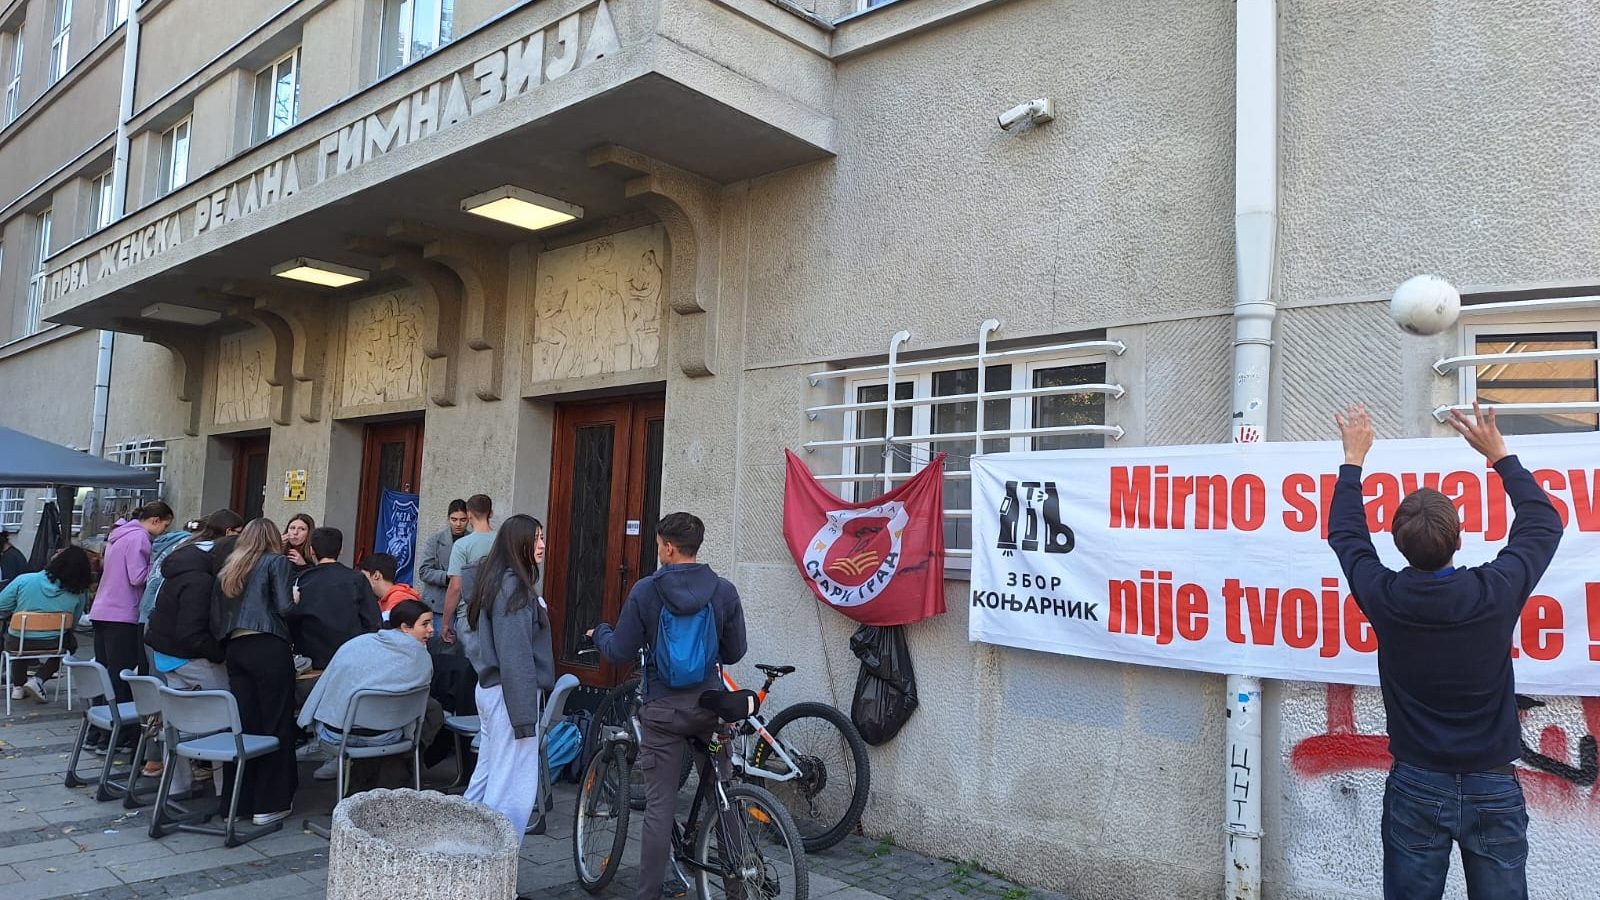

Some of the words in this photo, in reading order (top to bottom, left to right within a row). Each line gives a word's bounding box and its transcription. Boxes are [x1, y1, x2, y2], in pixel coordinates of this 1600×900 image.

[51, 258, 89, 299] ПРВА
[97, 212, 182, 281] ЖЕНСКА
[194, 154, 300, 237] РЕАЛНА
[317, 3, 622, 184] ГИМНАЗИЈА
[1109, 465, 1266, 532] Mirno
[806, 560, 854, 602] СТАРИ
[858, 552, 899, 598] ГРАД
[972, 590, 1099, 622] КОЊАРНИК
[1006, 572, 1062, 591] ЗБОР
[1108, 570, 1209, 645] nije
[1222, 578, 1378, 658] tvoje
